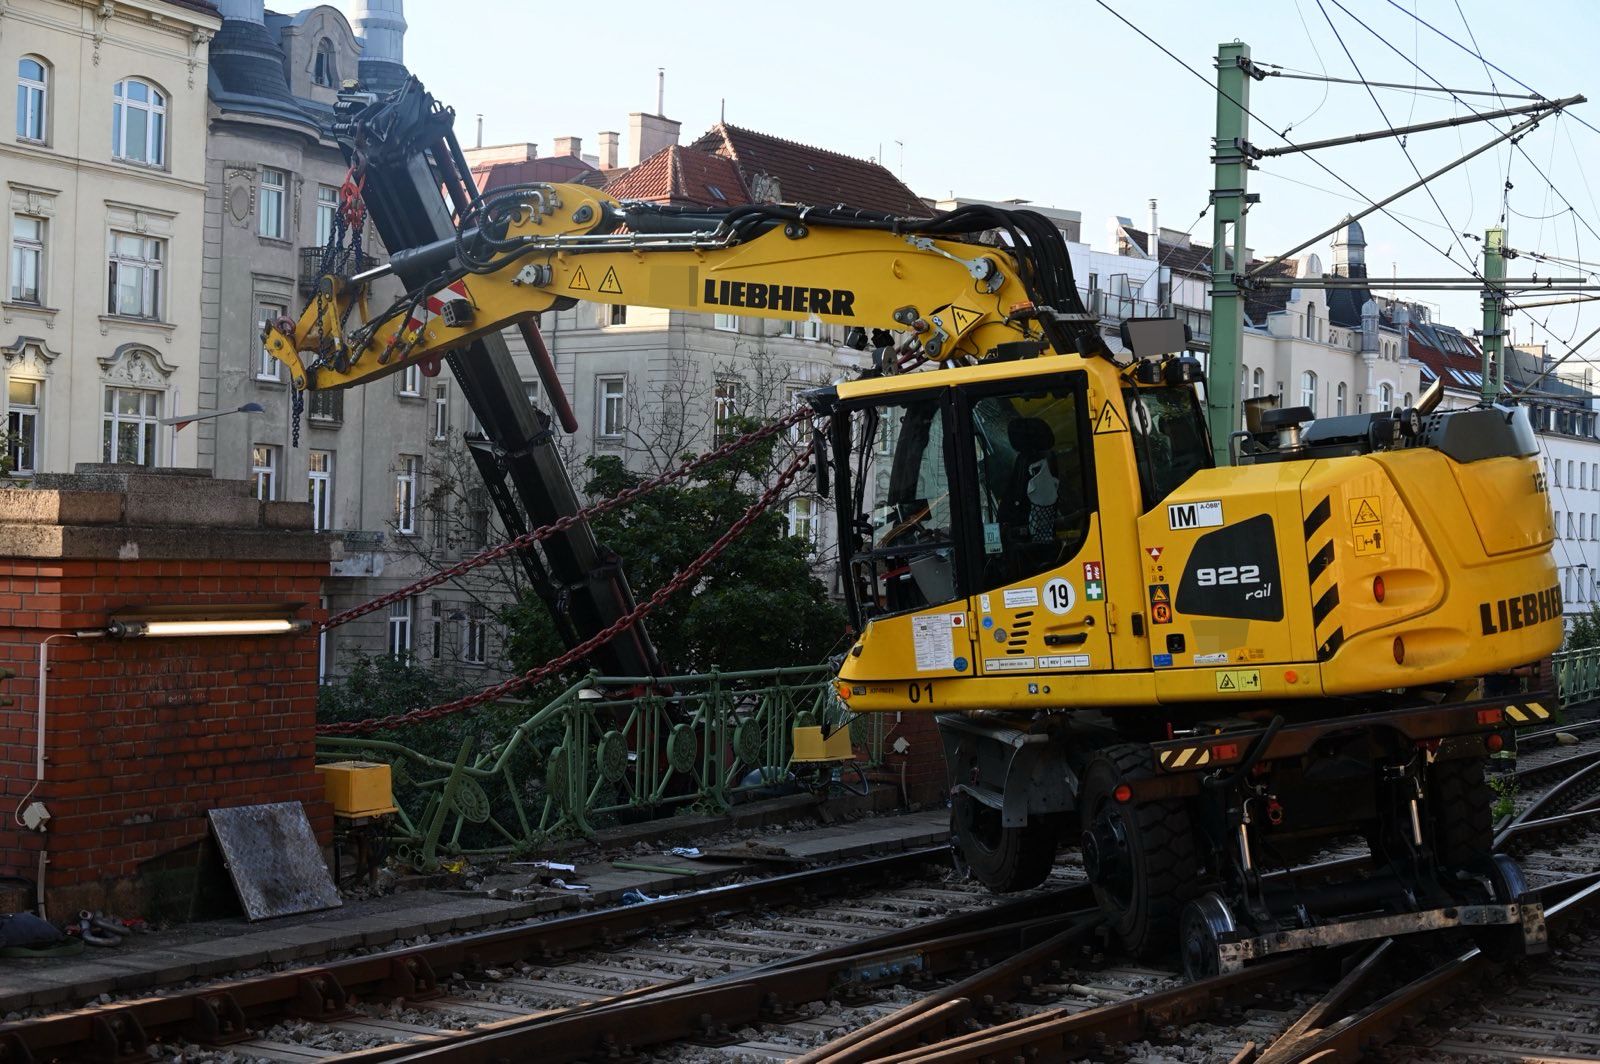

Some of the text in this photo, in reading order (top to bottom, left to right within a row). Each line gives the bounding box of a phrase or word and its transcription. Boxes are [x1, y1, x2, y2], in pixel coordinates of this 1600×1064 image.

[704, 279, 855, 316] LIEBHERR
[1170, 505, 1197, 528] IM
[1196, 565, 1260, 586] 922
[1049, 584, 1069, 609] 19
[1245, 582, 1272, 600] rail
[908, 682, 934, 704] 01
